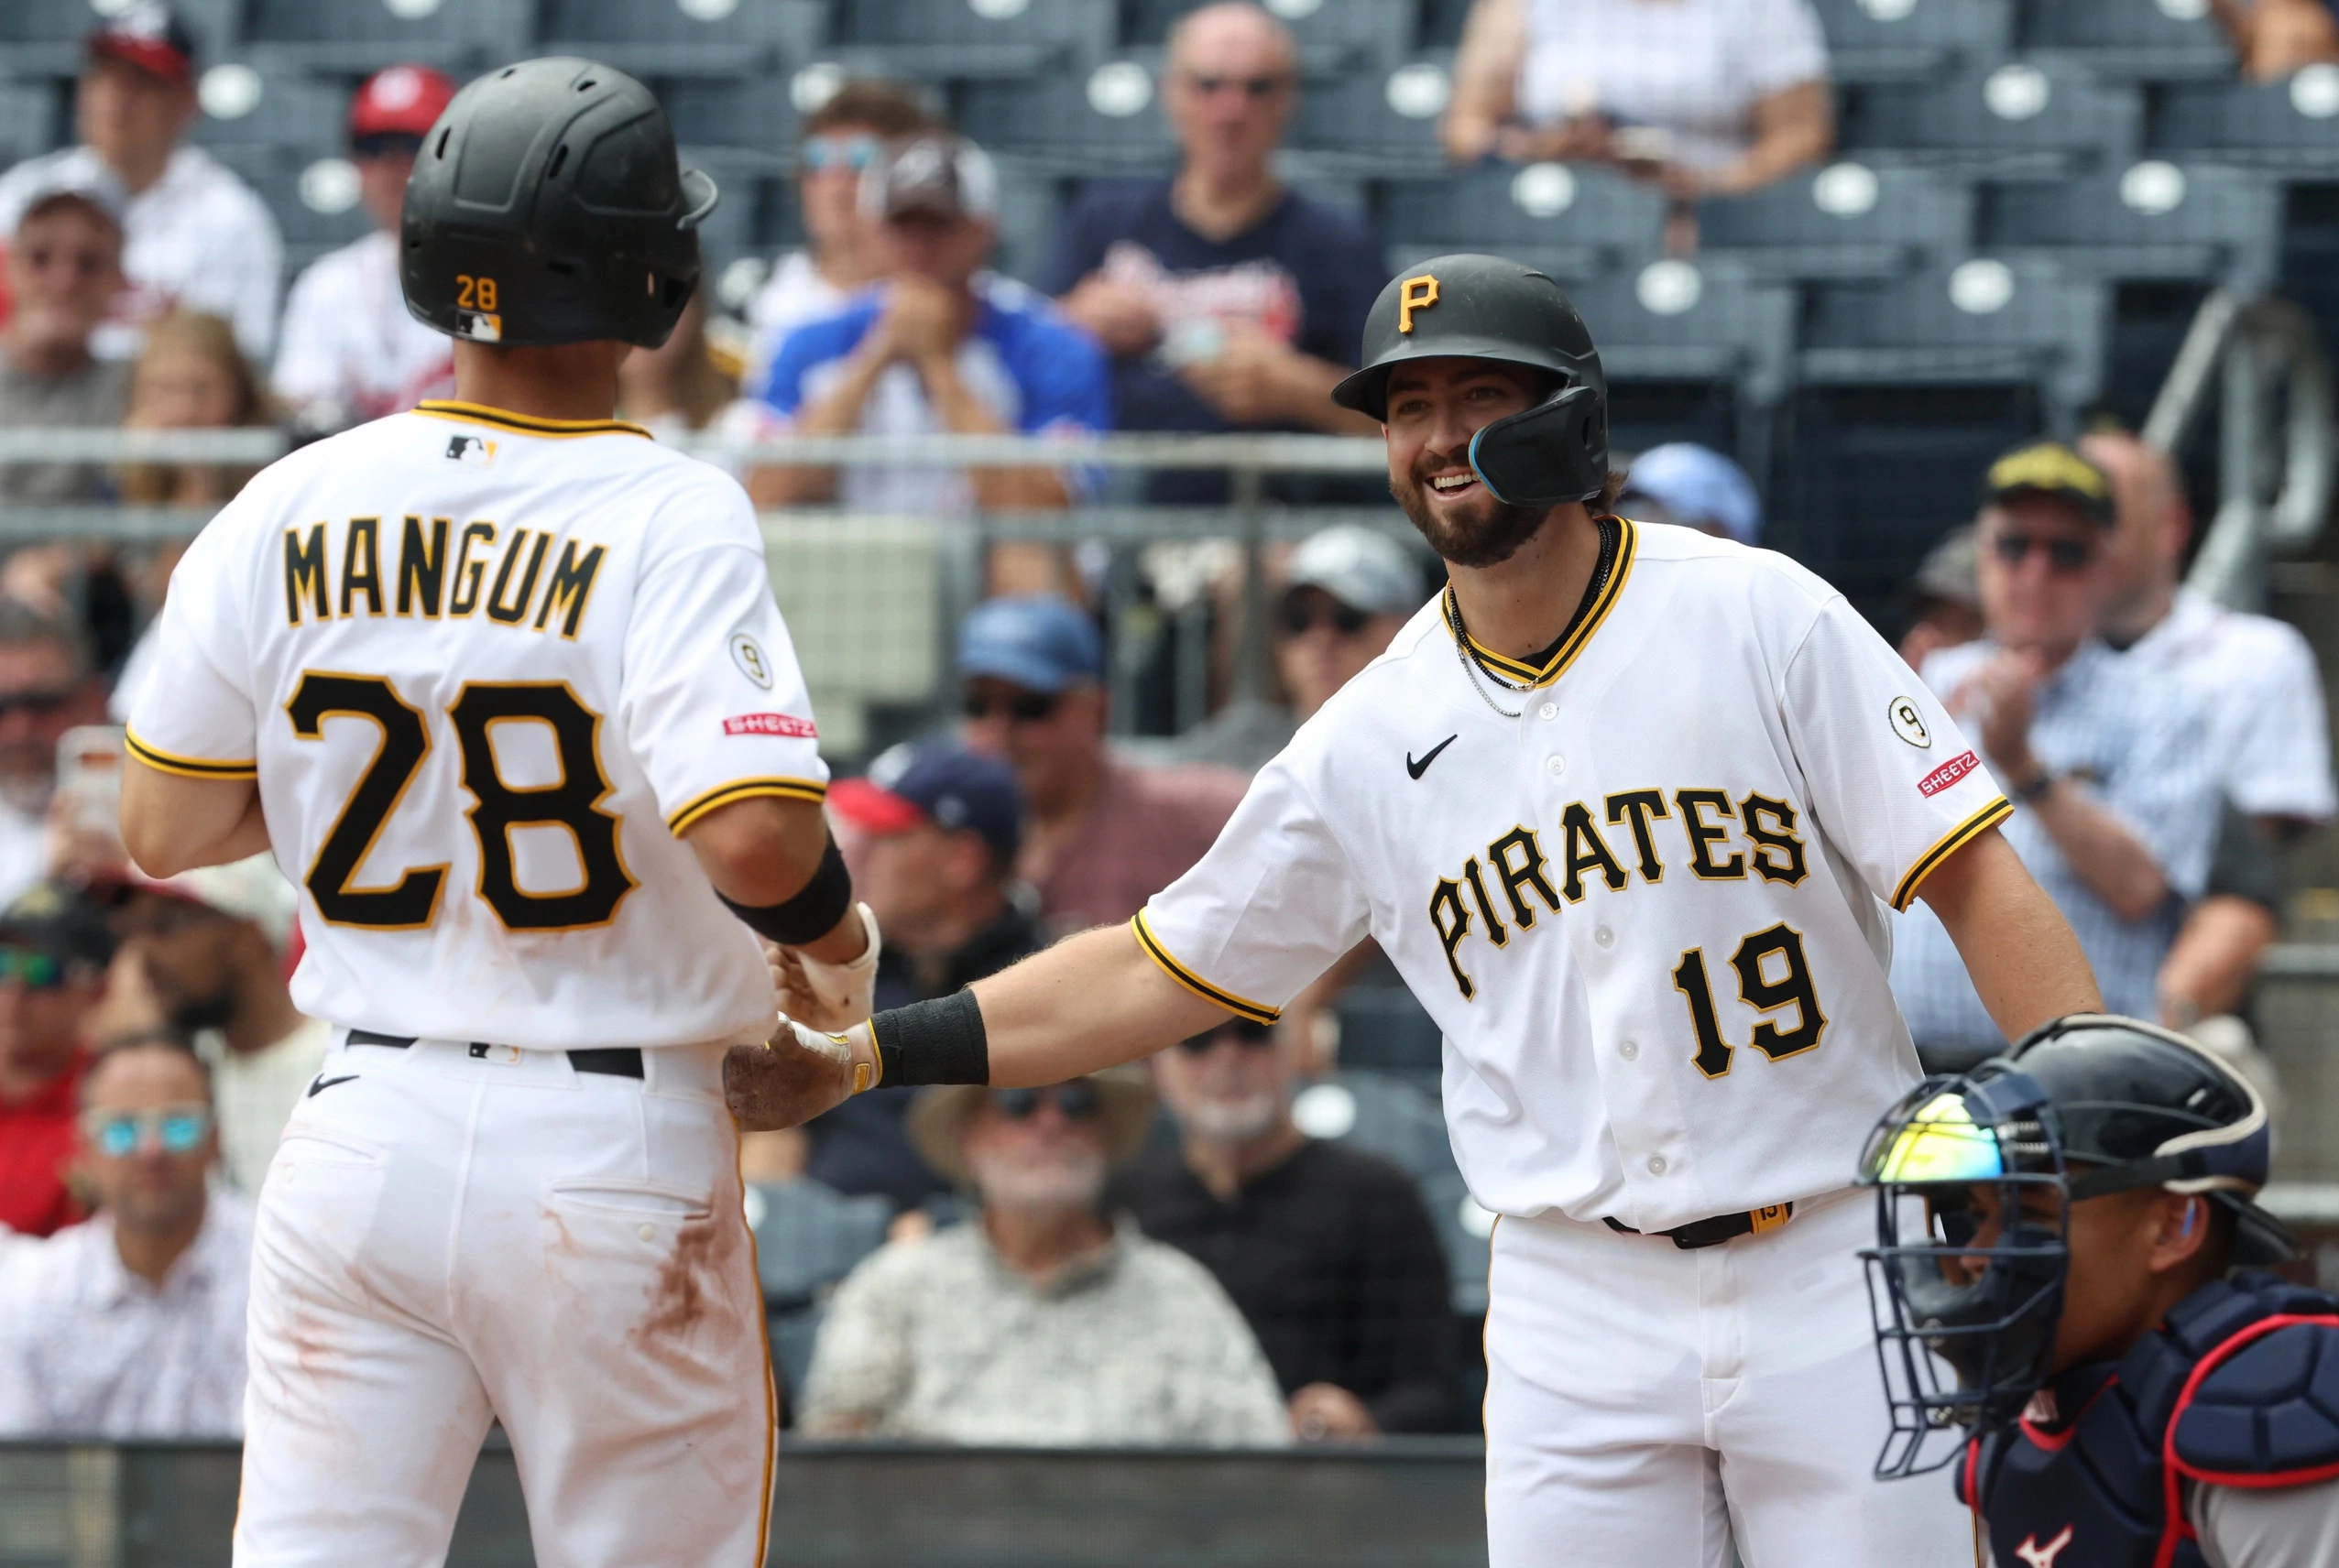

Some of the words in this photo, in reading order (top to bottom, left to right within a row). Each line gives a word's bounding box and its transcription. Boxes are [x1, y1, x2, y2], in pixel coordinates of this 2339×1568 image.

[456, 275, 497, 310] 28
[1398, 274, 1440, 333] P
[284, 516, 608, 640] MANGUM
[741, 645, 764, 679] 9
[1898, 704, 1926, 739] 9
[284, 671, 639, 931] 28
[1920, 753, 1977, 794] SHEETZ
[1429, 789, 1809, 1001] PIRATES
[1673, 922, 1828, 1079] 19
